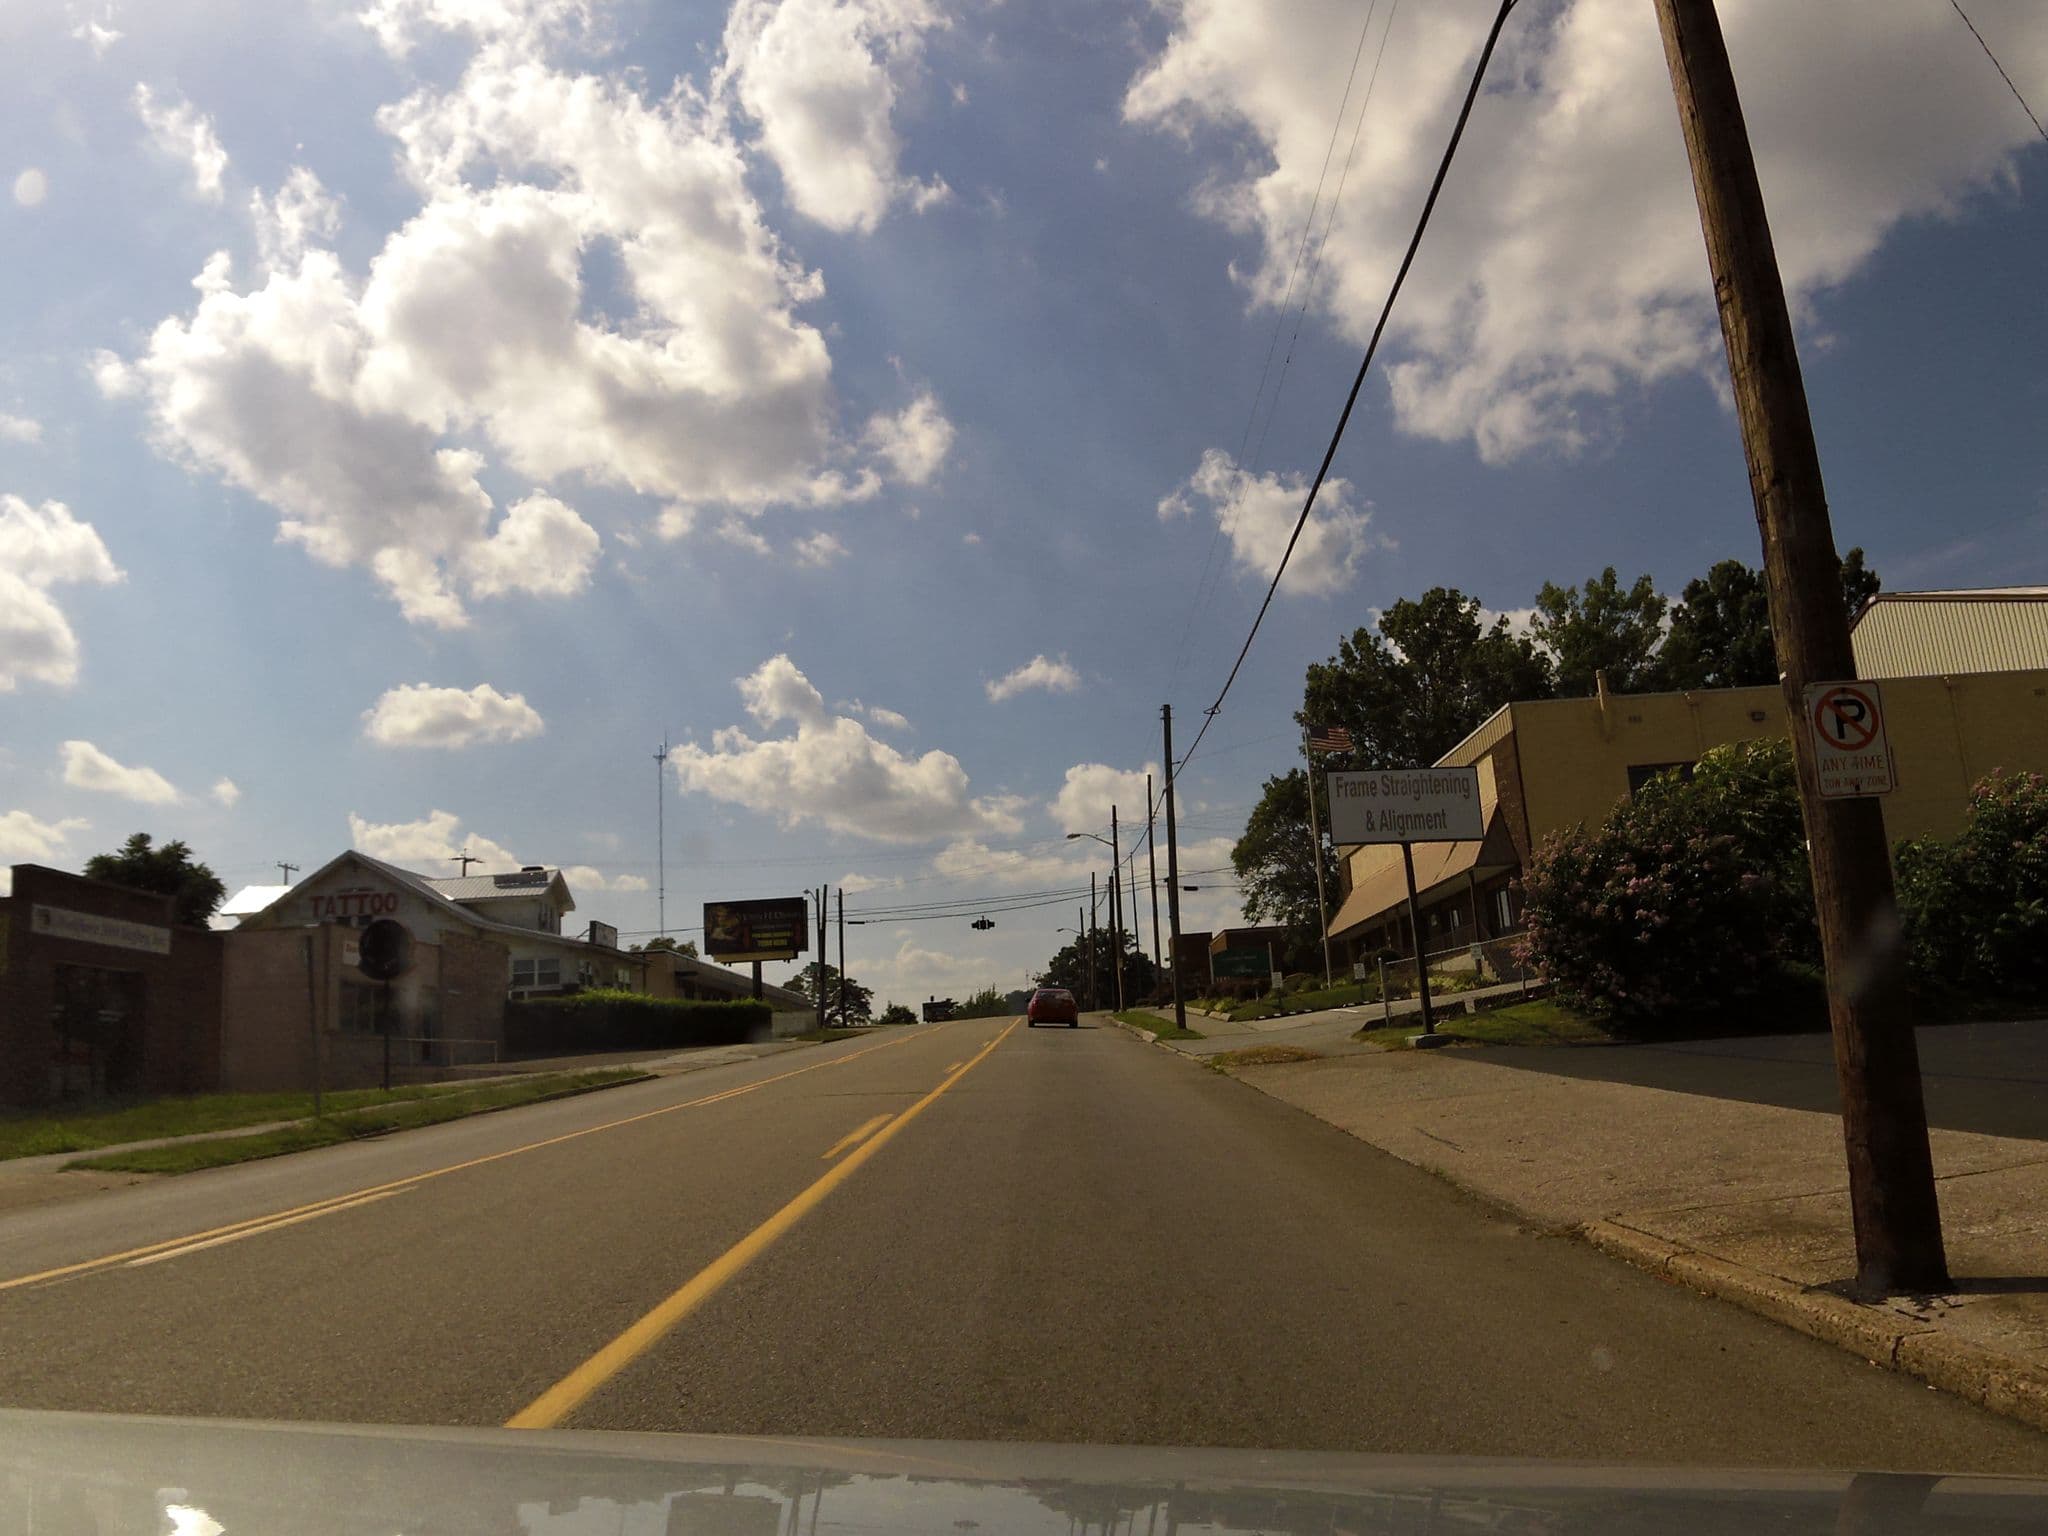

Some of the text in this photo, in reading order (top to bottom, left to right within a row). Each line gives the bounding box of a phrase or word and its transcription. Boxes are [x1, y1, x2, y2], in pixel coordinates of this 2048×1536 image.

[1822, 754, 1885, 773] ANY TIME
[1335, 773, 1470, 801] Frame Straightening
[1366, 808, 1448, 837] & Alignment
[311, 892, 399, 918] TATTOO
